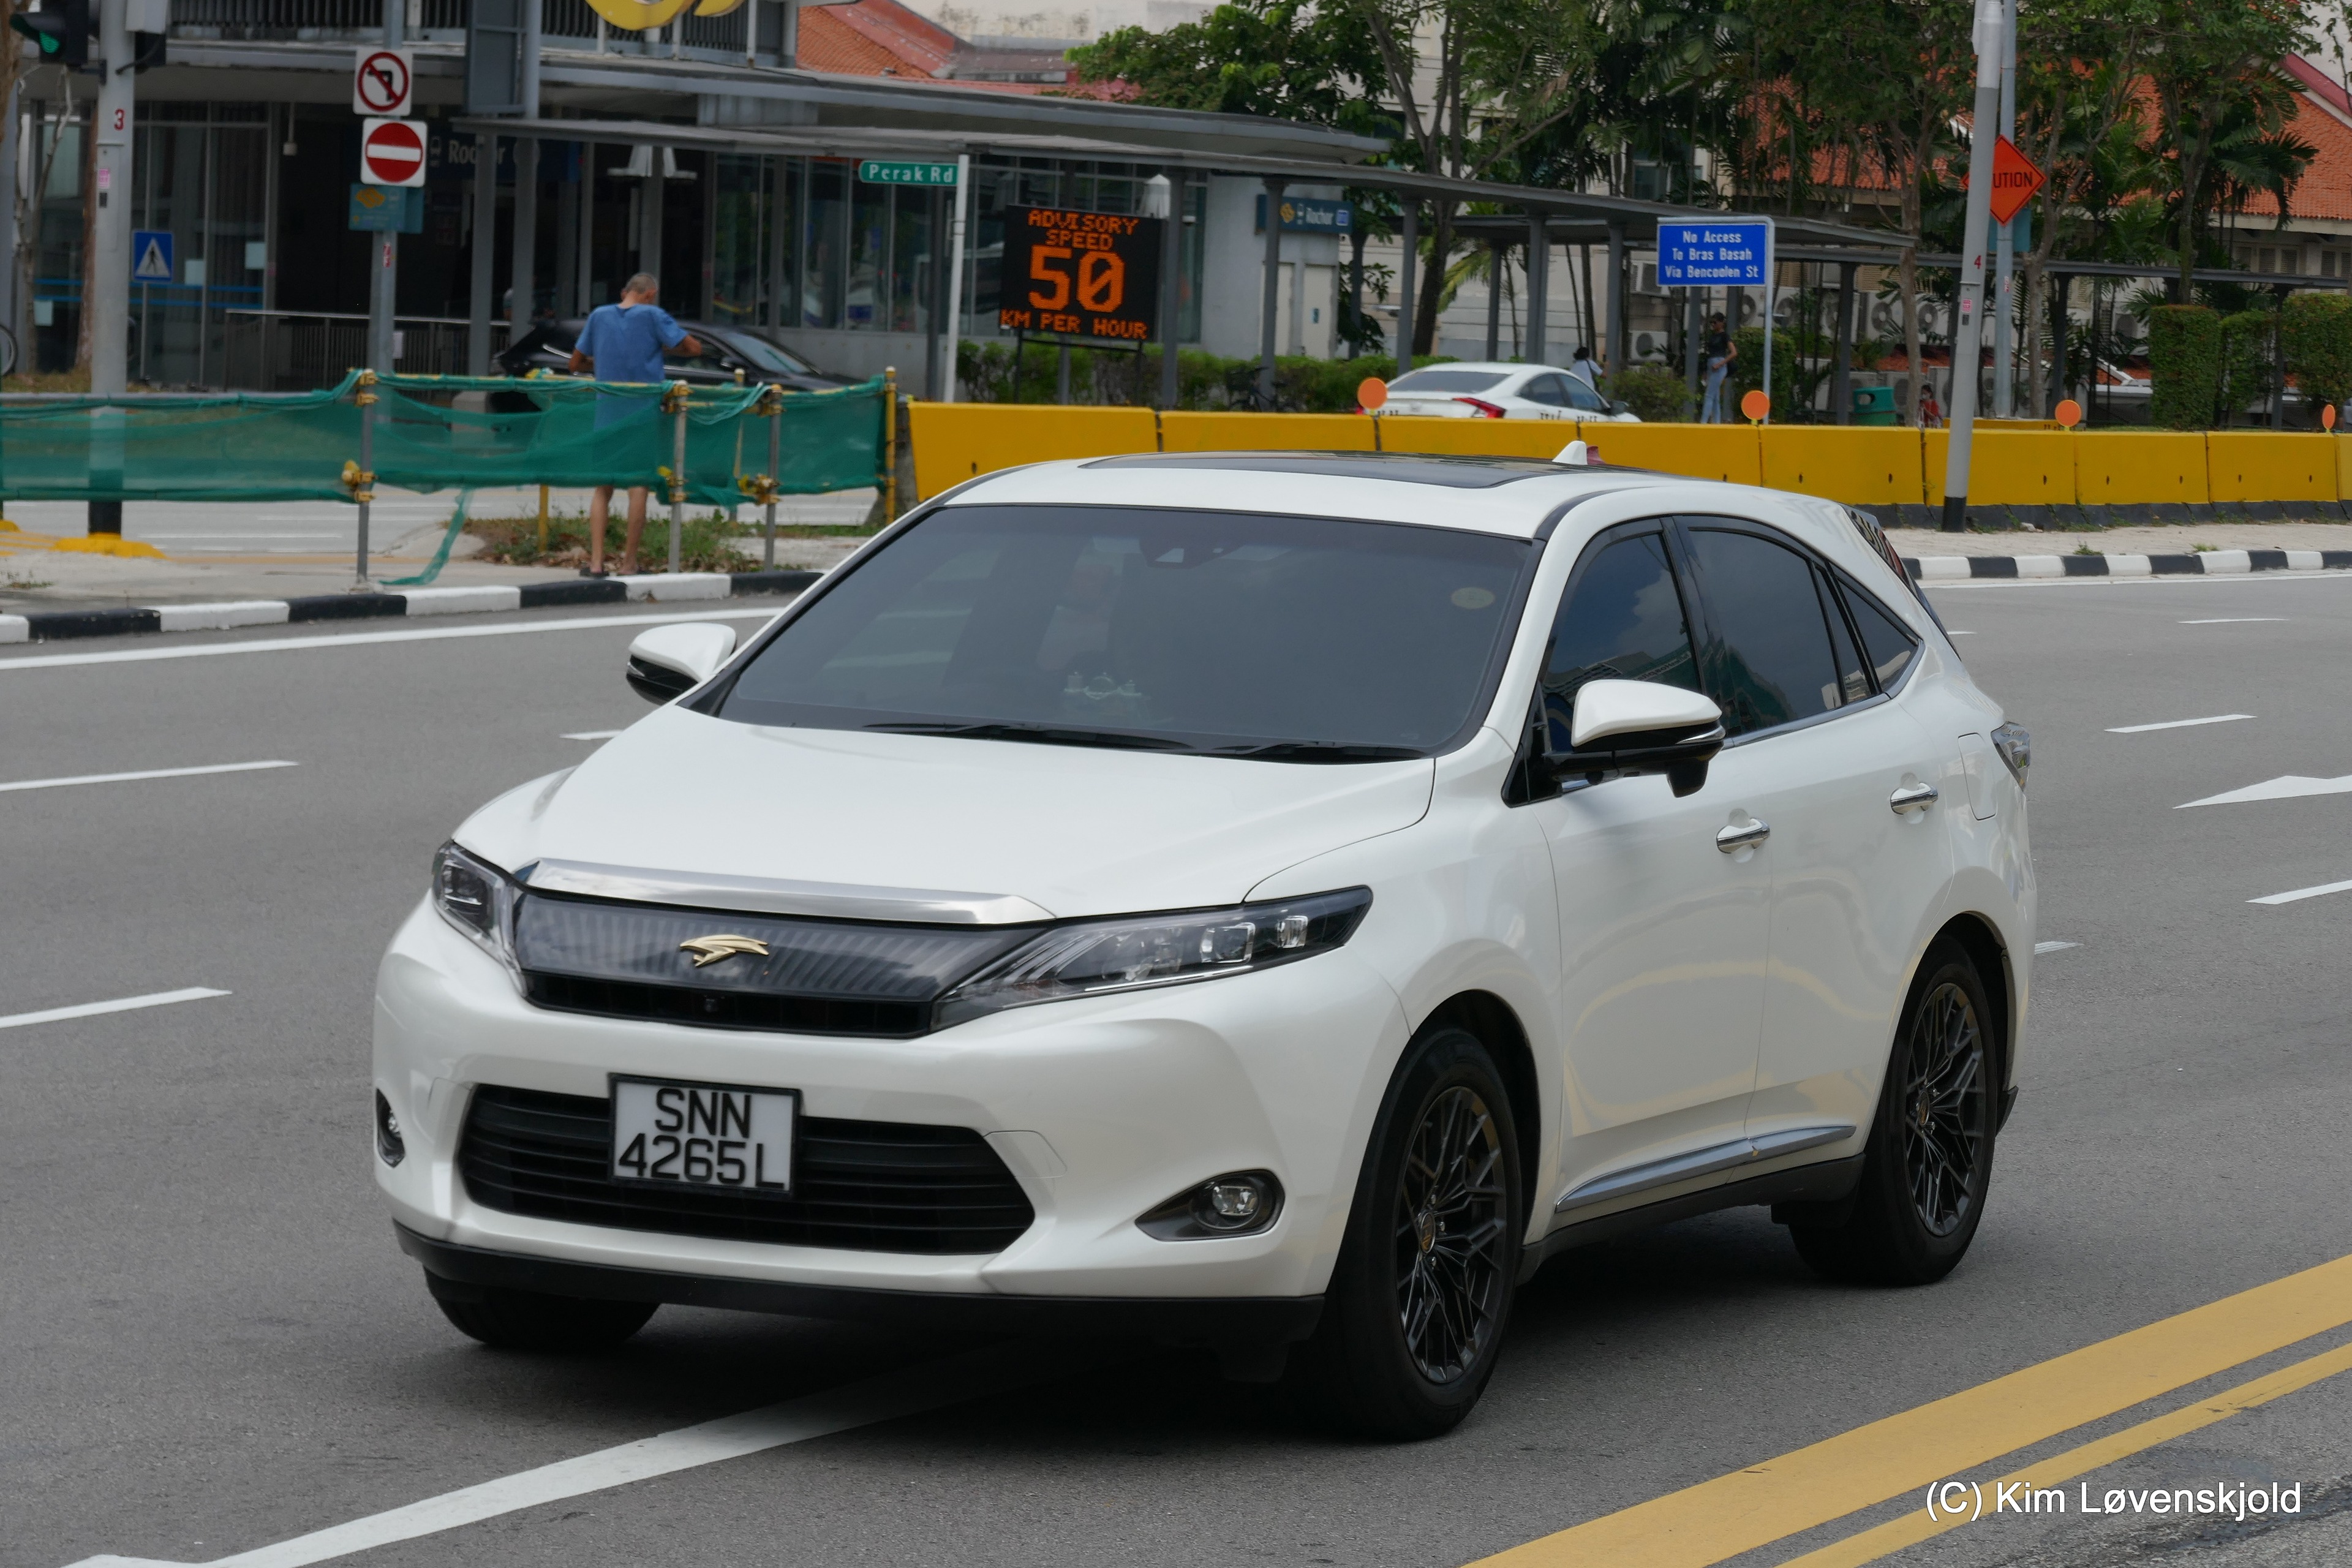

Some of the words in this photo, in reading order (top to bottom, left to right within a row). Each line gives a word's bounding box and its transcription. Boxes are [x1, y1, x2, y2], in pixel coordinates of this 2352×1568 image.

[114, 108, 125, 131] 3
[448, 139, 506, 165] Rocr
[869, 164, 923, 182] Perak
[930, 166, 954, 183] Rd
[1992, 172, 2033, 189] UTION
[1028, 209, 1139, 235] ADVISORY
[1045, 228, 1114, 251] SPEED
[1683, 230, 1698, 243] No
[1703, 230, 1742, 243] Access
[1672, 247, 1684, 261] To
[1689, 247, 1714, 261] Bras
[1719, 247, 1752, 261] Basah
[1973, 255, 1982, 270] 4
[1028, 244, 1126, 313] 50
[1665, 265, 1682, 278] Via
[1687, 265, 1741, 278] Bencoolen
[1746, 265, 1759, 278] St
[1000, 308, 1032, 328] KM
[1039, 311, 1082, 334] PER
[1092, 317, 1148, 340] HOUR
[655, 1087, 752, 1139] SNN
[617, 1132, 785, 1189] 4265L
